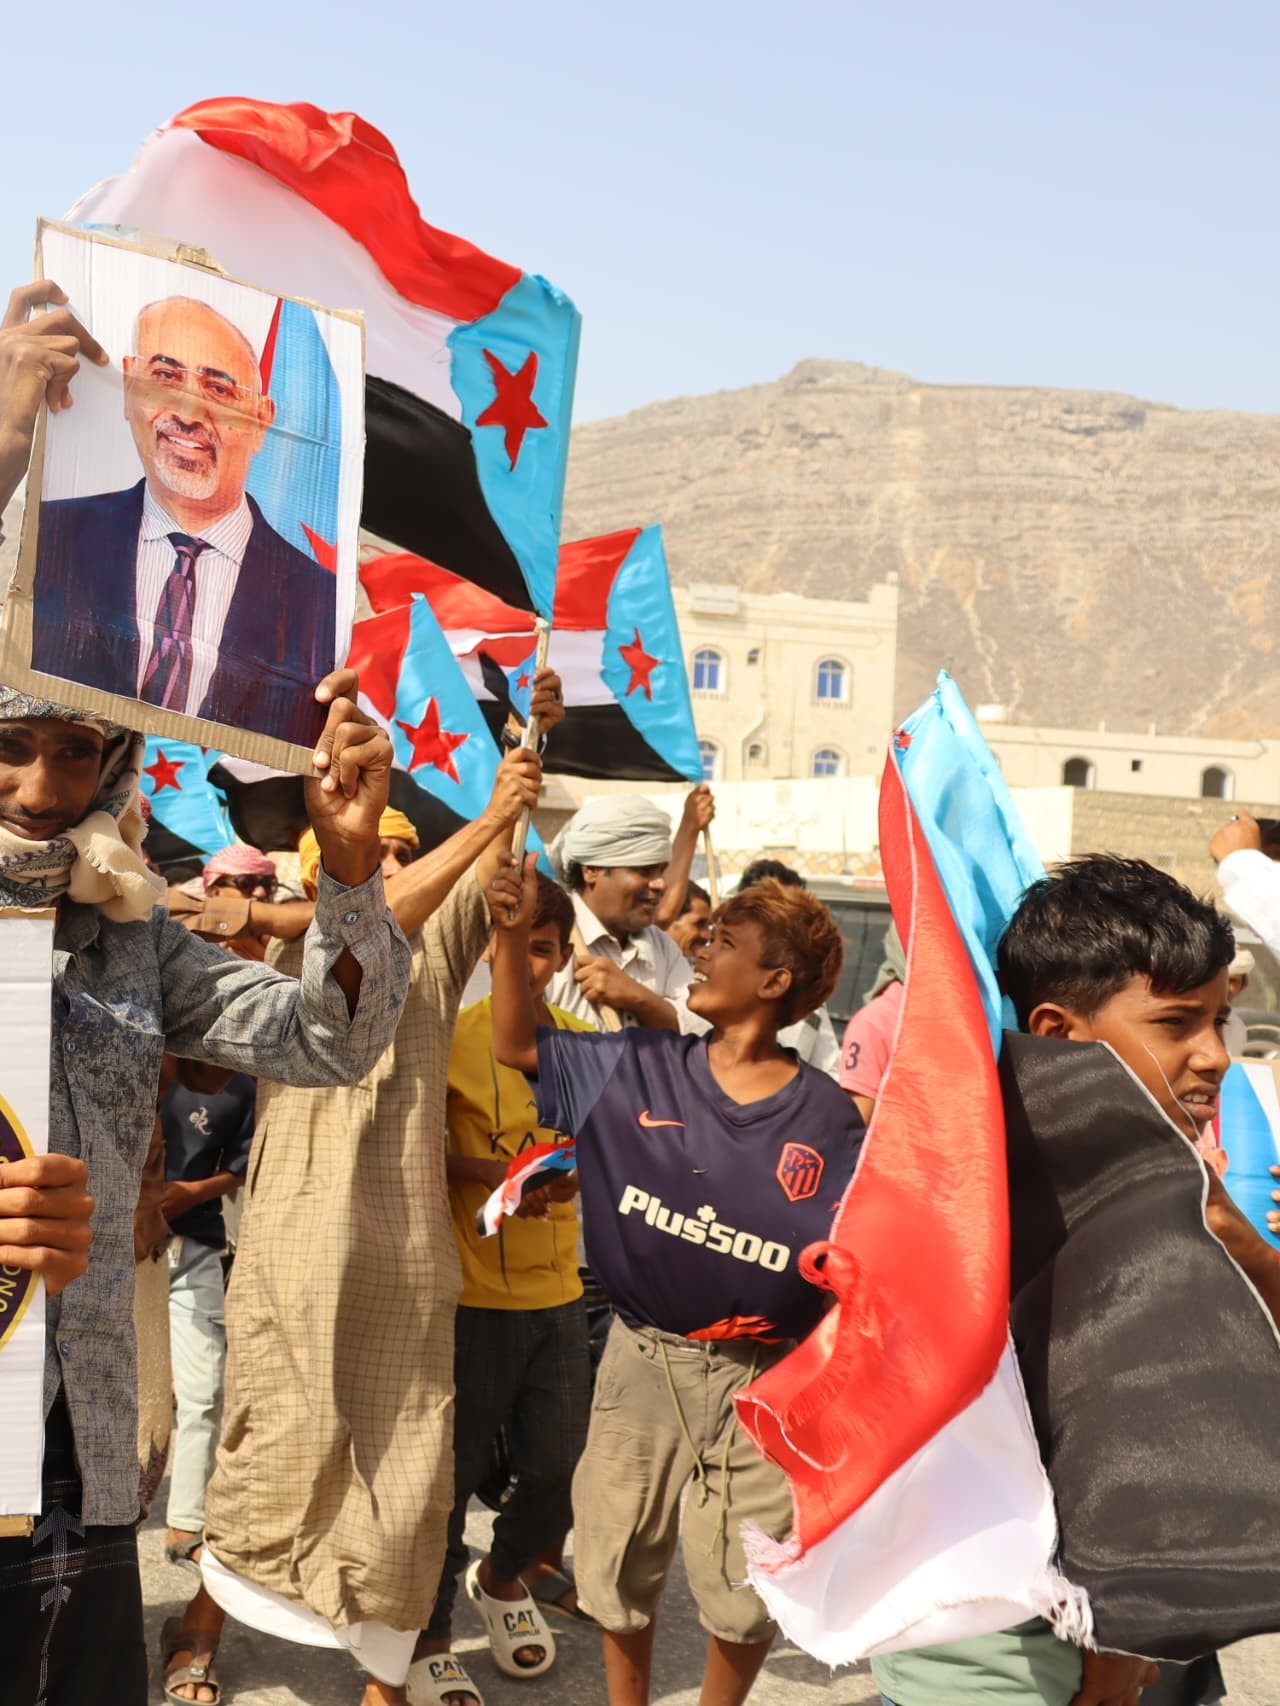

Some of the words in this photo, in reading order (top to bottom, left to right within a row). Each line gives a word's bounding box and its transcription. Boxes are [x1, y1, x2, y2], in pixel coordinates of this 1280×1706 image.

[845, 1041, 861, 1071] 3
[618, 1184, 791, 1273] Plus500
[503, 1610, 536, 1633] CAT
